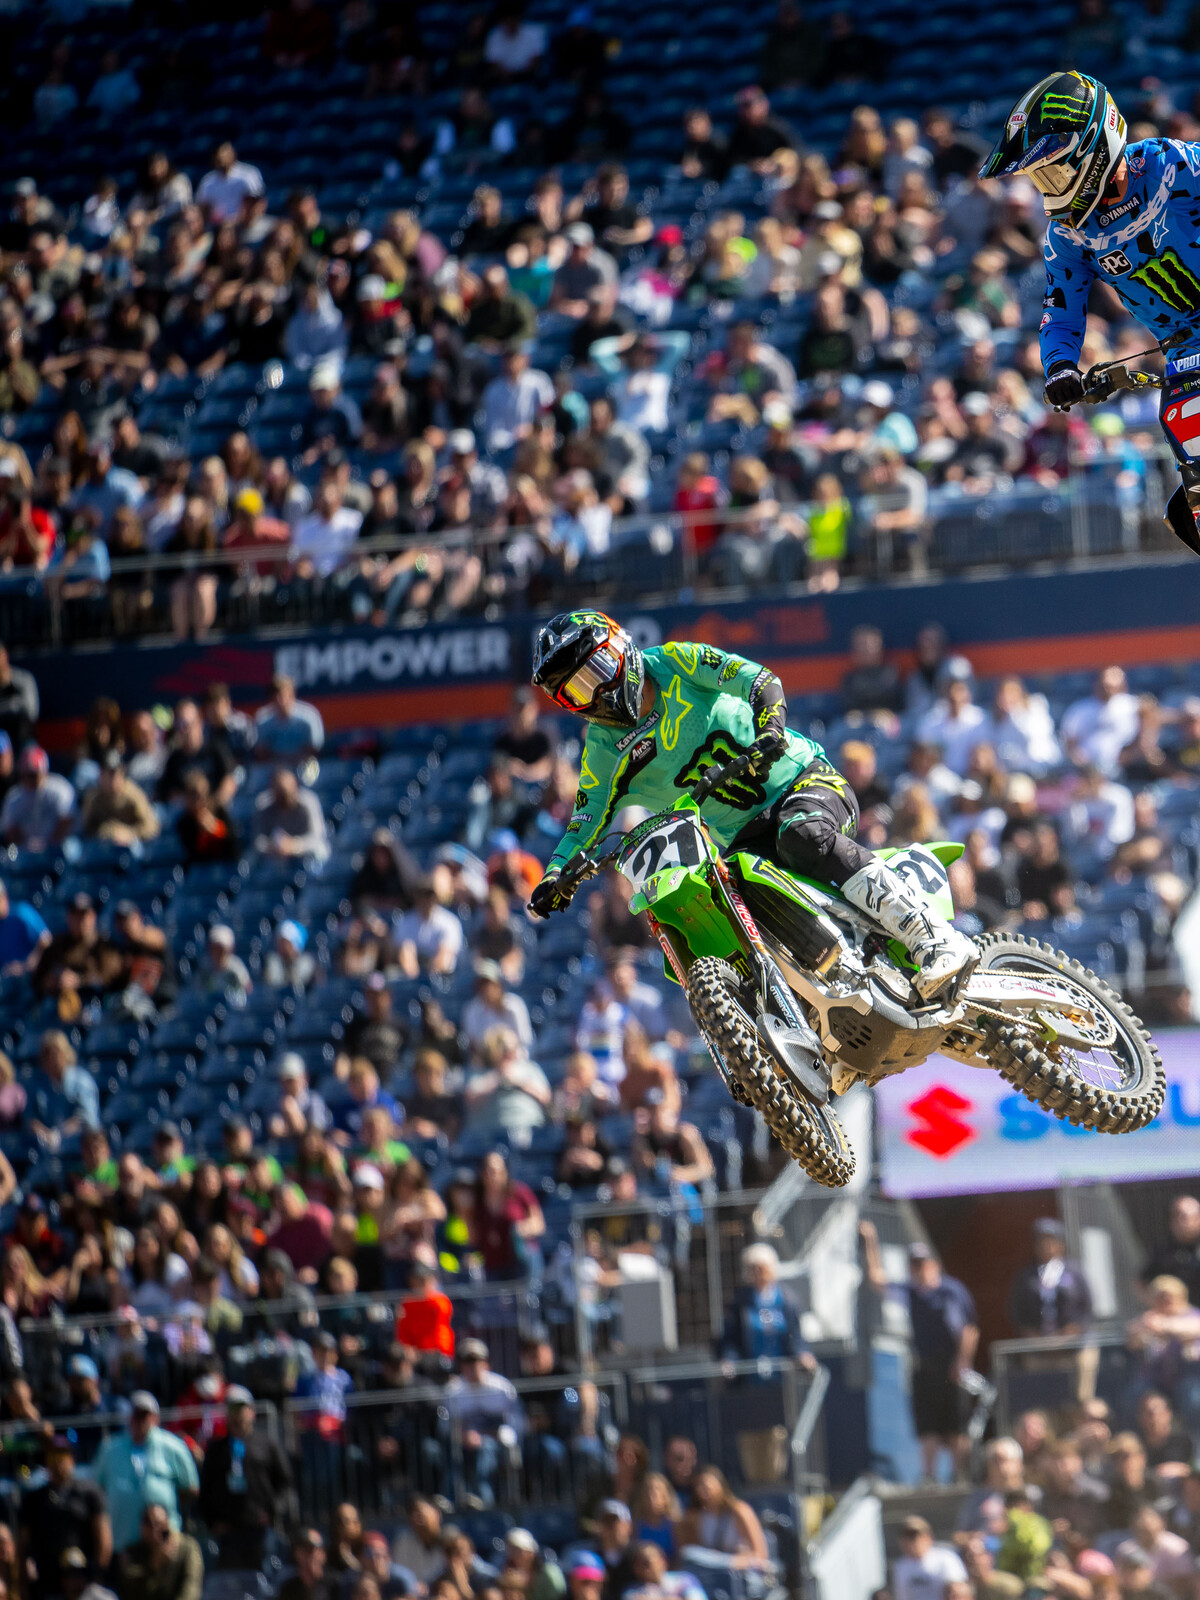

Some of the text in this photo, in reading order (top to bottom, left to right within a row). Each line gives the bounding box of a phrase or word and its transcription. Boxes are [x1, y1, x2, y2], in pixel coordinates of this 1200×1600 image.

[1010, 114, 1025, 122] BELL
[1080, 151, 1106, 197] MONSTER
[1107, 196, 1140, 221] YAMAHA
[273, 627, 511, 687] EMPOWER
[616, 711, 660, 751] Kawasaki
[632, 818, 701, 882] 21
[895, 849, 948, 896] 21
